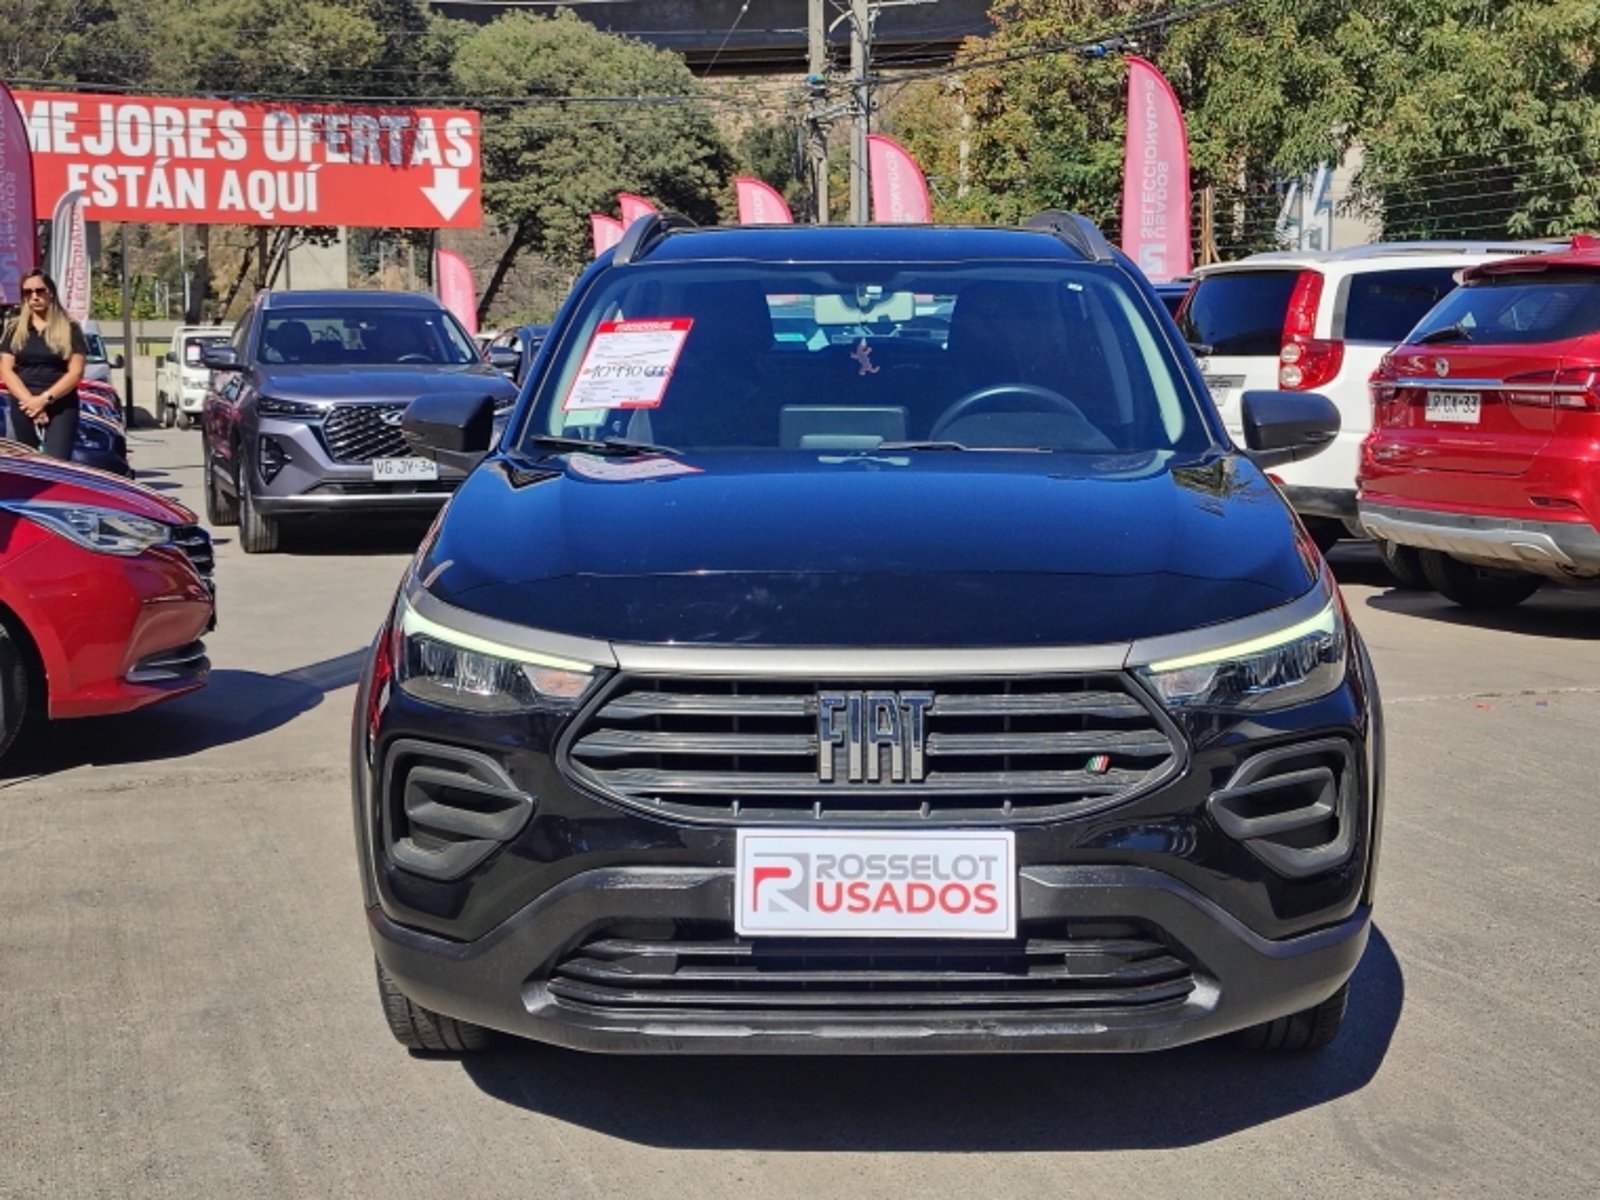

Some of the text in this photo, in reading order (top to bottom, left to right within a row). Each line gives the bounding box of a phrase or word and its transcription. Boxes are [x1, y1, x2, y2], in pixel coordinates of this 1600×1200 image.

[17, 101, 474, 168] MEJORES OFERTAS
[67, 157, 324, 219] ESTÁN AQUÍ
[818, 691, 935, 782] FIAT
[816, 854, 999, 880] ROSSELOT
[816, 883, 999, 914] USADOS
